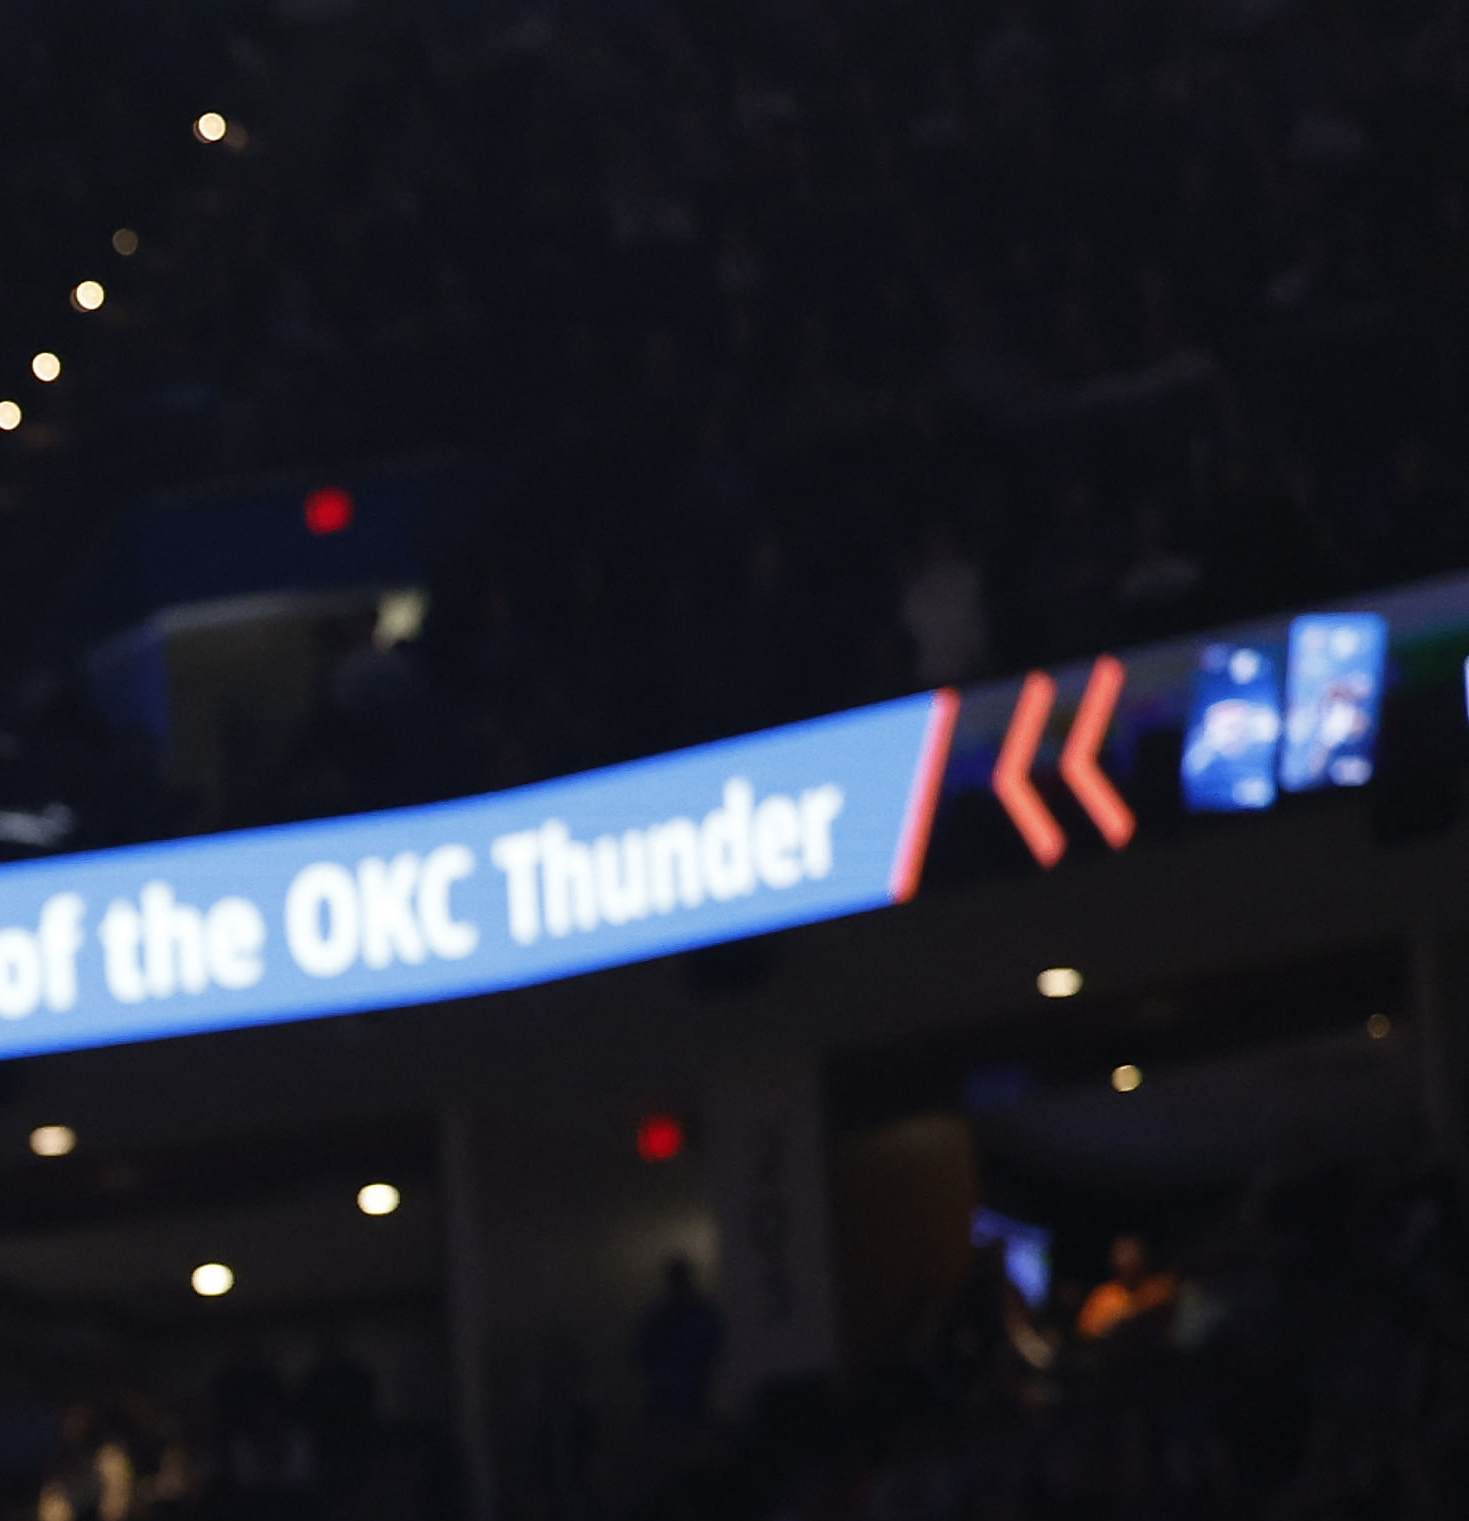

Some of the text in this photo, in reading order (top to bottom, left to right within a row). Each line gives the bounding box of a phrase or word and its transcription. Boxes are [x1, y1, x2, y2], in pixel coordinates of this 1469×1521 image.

[99, 879, 268, 1004] the
[284, 843, 479, 978] OKC
[491, 775, 845, 946] Thunder
